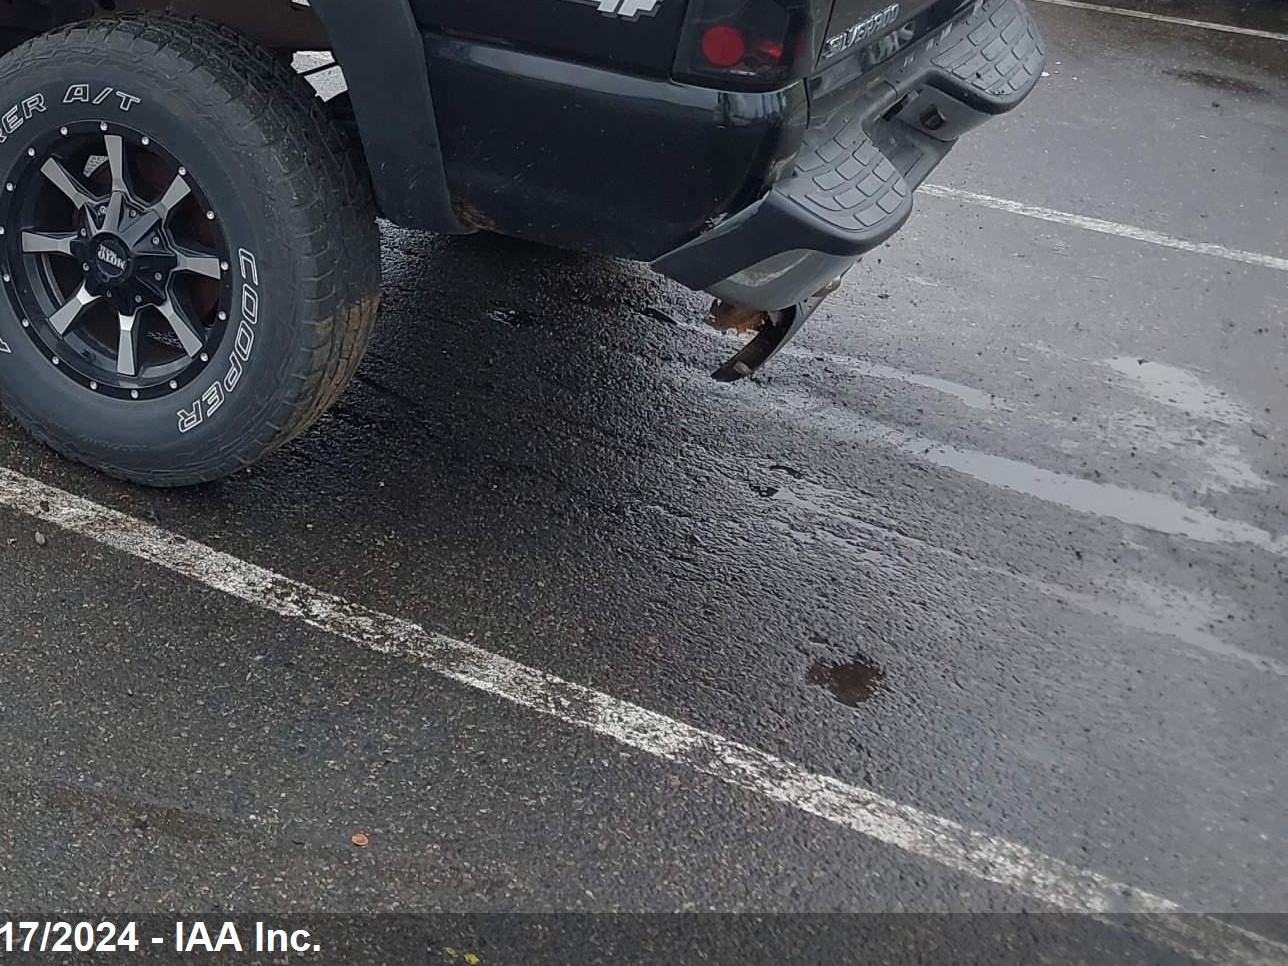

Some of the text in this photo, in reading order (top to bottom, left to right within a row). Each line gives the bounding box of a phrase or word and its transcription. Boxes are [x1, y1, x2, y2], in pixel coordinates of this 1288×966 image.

[821, 2, 900, 59] SILVERADO
[63, 84, 141, 111] A/T
[97, 249, 127, 270] MOTO
[177, 248, 258, 433] COOPER
